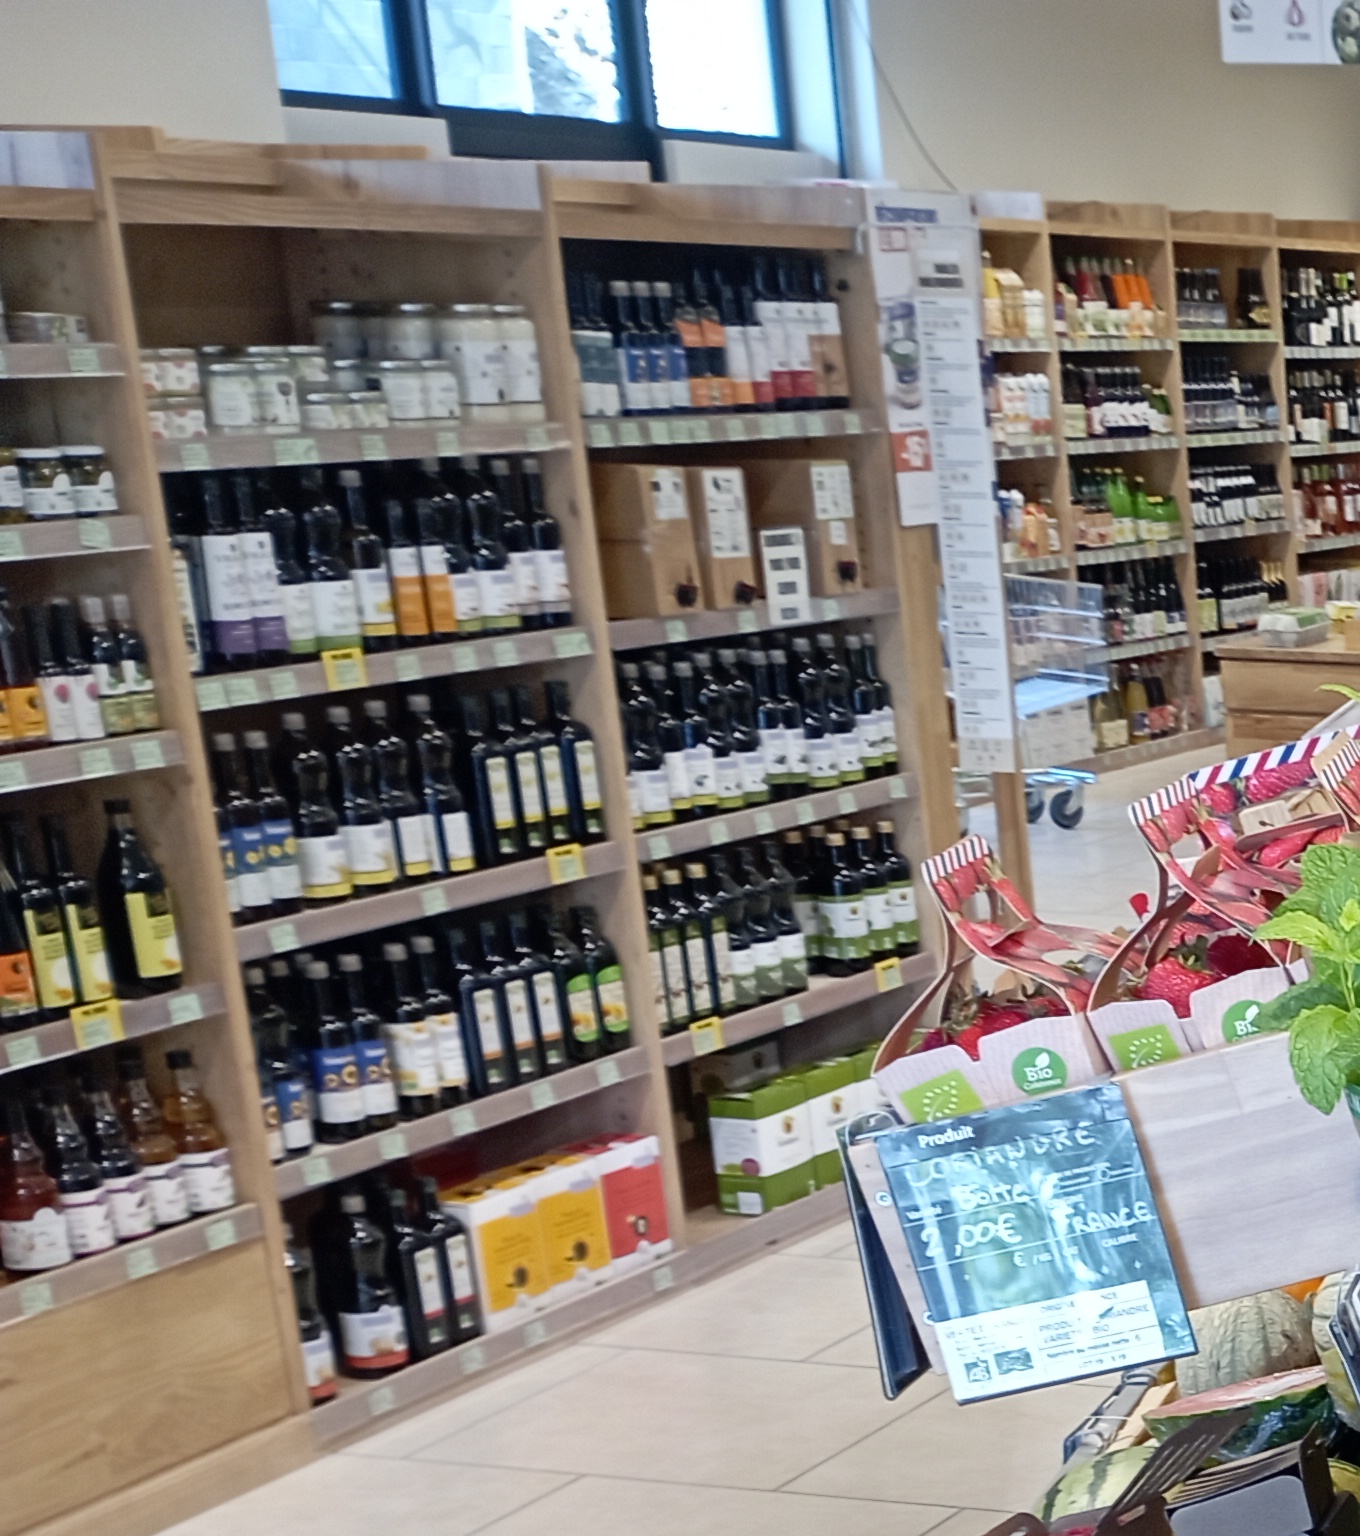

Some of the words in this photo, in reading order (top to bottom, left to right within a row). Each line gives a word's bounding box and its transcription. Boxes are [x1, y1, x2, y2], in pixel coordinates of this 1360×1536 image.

[1023, 1066, 1053, 1082] Bio
[917, 1125, 976, 1149] Produit
[1051, 1201, 1155, 1242] FRANCE
